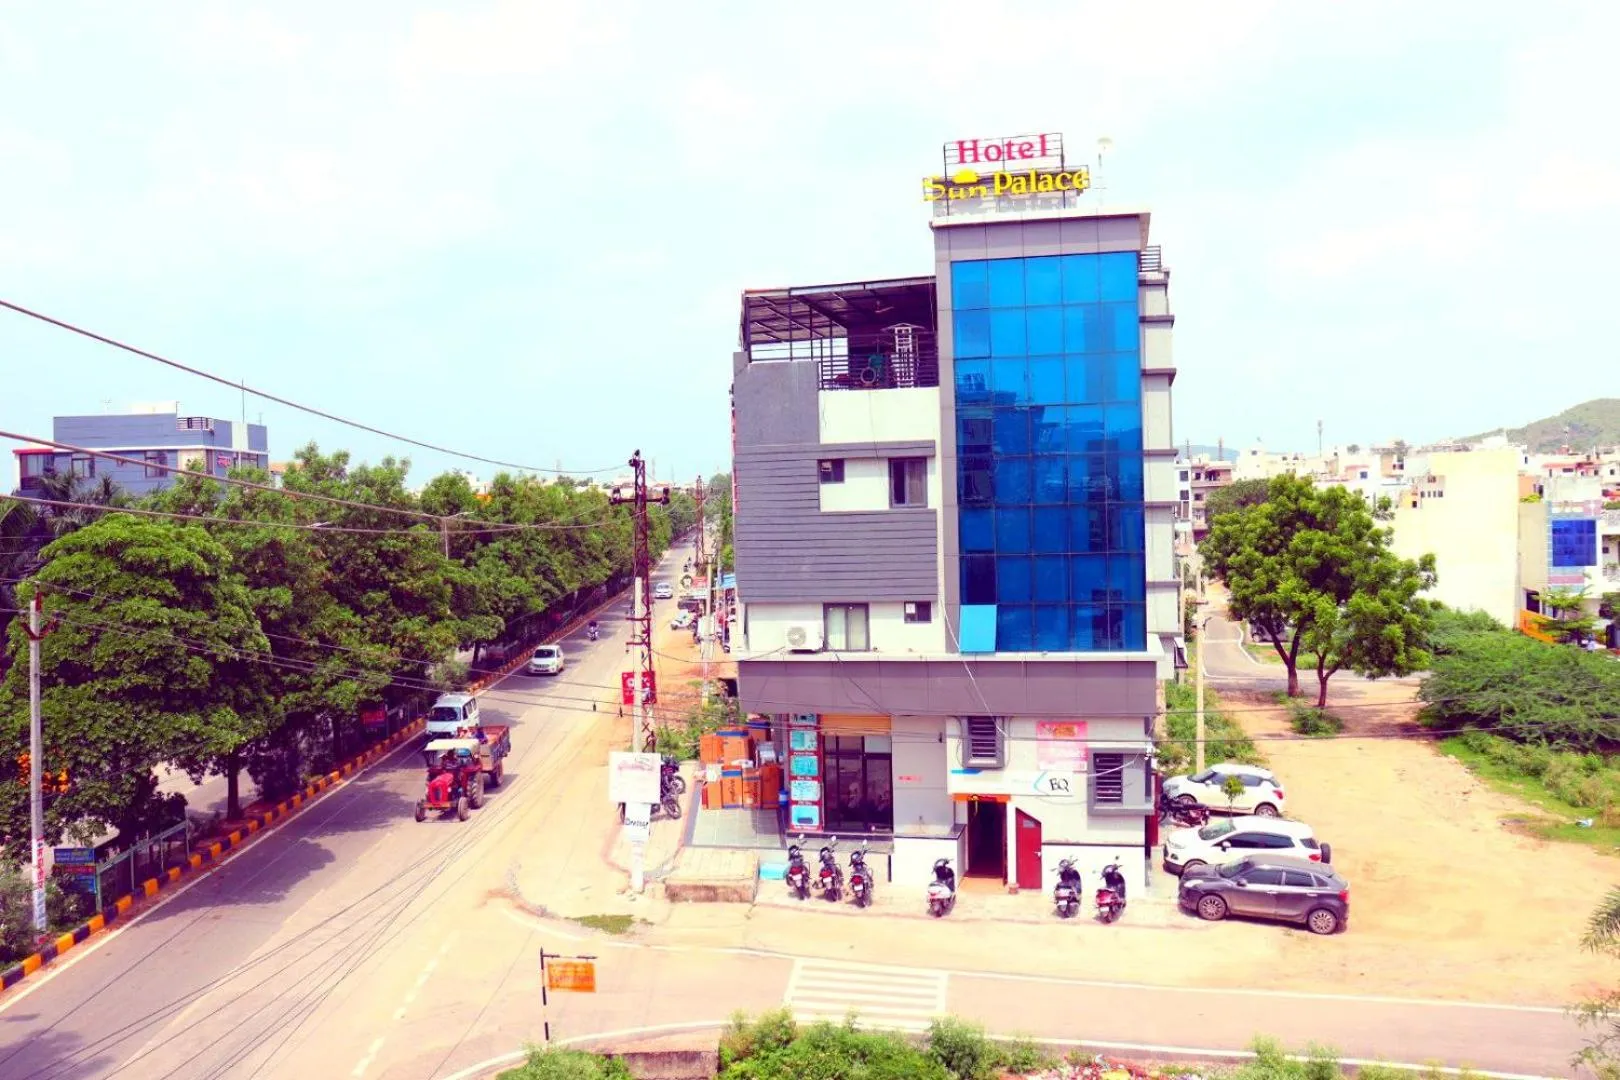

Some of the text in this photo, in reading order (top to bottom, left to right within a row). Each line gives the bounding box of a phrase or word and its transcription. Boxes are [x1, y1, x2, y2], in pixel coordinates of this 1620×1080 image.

[957, 134, 1047, 163] Hotel
[923, 169, 1089, 201] Sun Palace
